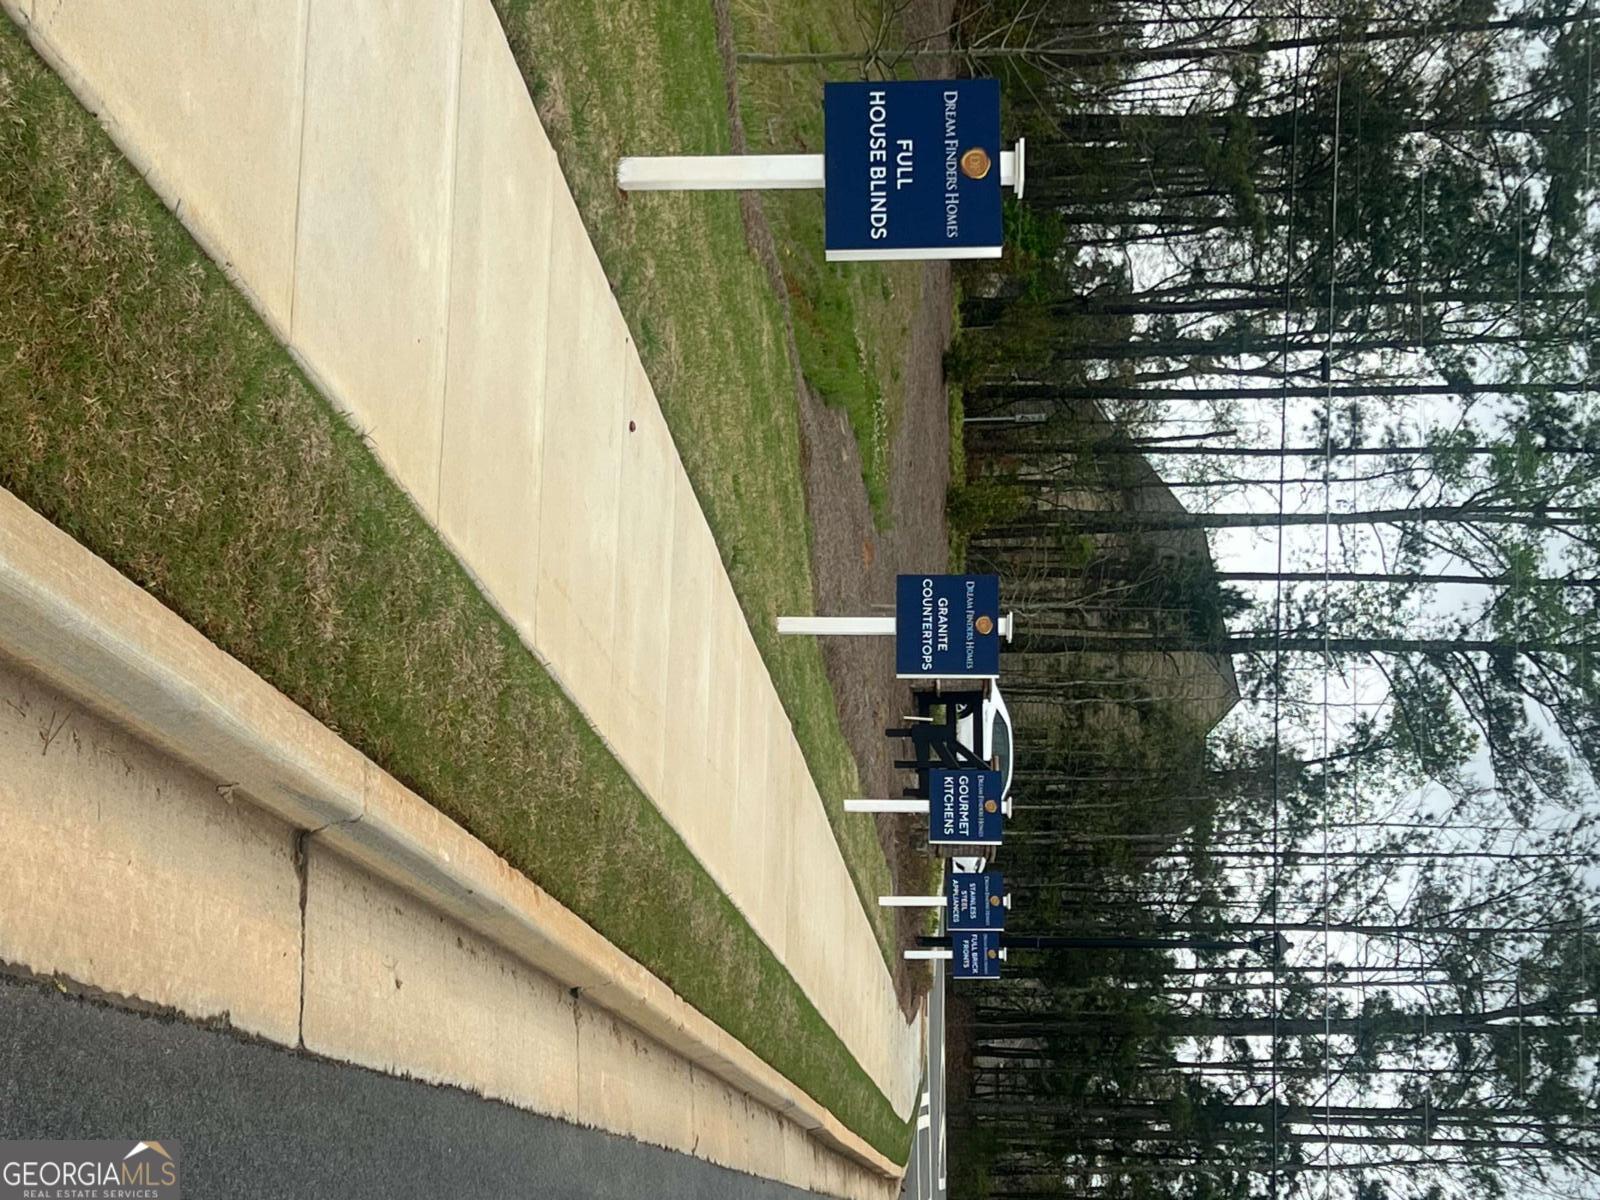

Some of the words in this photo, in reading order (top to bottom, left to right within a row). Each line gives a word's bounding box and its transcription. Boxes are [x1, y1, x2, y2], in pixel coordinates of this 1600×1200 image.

[869, 91, 887, 163] HOUSE
[943, 91, 959, 137] DREAM
[896, 139, 913, 190] FULL
[944, 139, 959, 191] FINDERS
[870, 166, 887, 240] BLINDS
[945, 192, 960, 238] HOMES
[922, 579, 933, 670] COUNTERTOPS
[938, 597, 949, 652] GRANITE
[944, 777, 954, 835] KITCHENS
[959, 776, 969, 836] GOURMET
[969, 883, 977, 919] STAINLESS
[971, 952, 979, 974] BRICK
